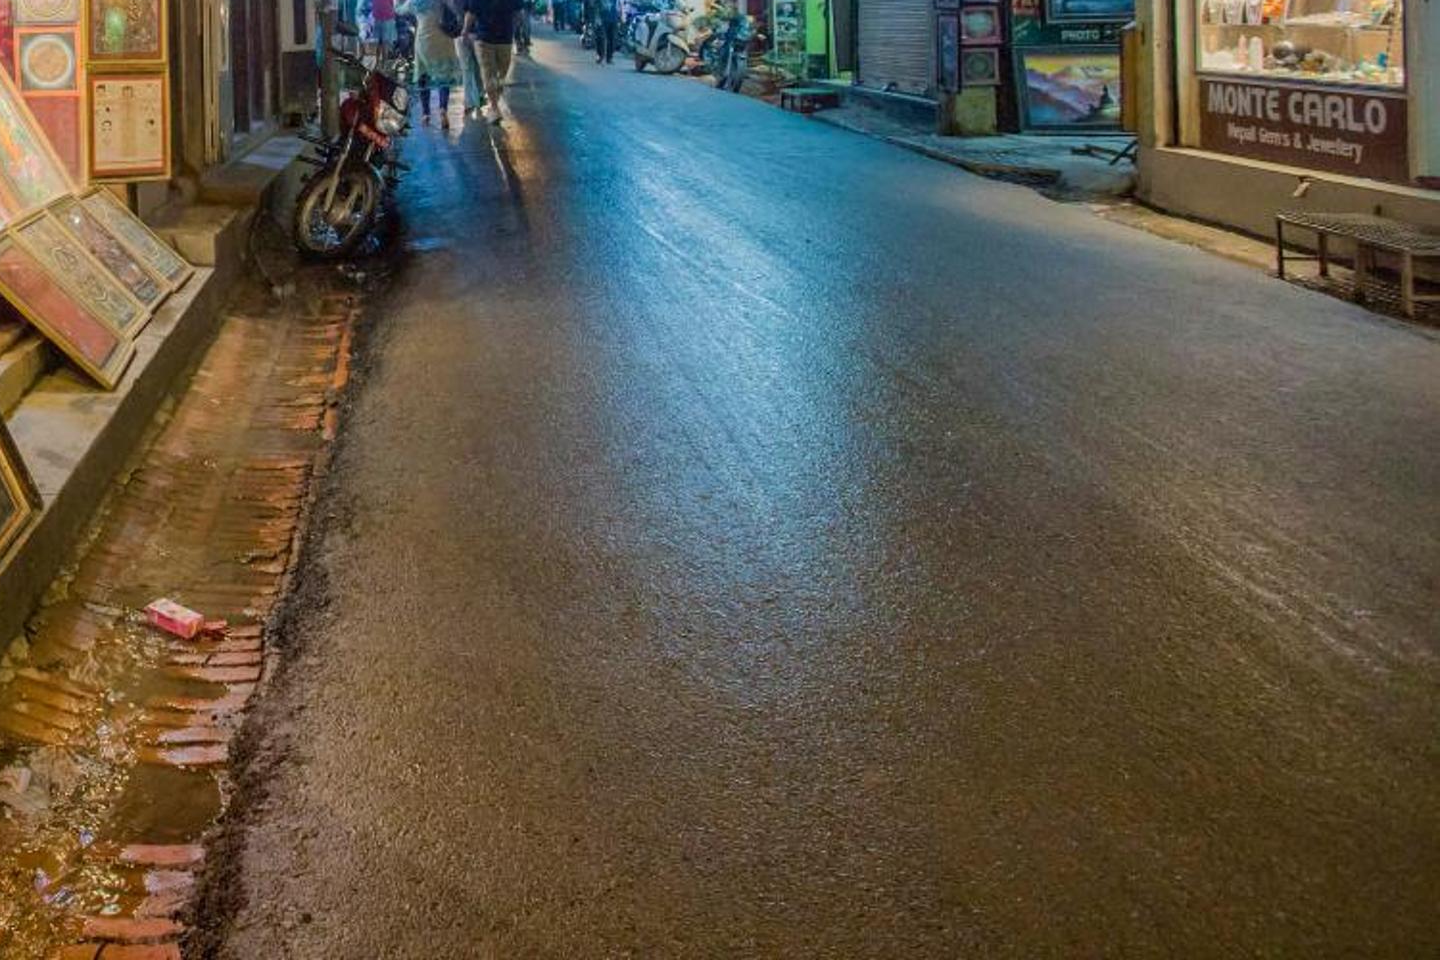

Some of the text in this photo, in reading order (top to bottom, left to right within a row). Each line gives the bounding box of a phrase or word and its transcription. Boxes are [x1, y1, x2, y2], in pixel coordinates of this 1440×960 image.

[1207, 82, 1388, 135] MONTE CARLO
[1293, 132, 1303, 150] &
